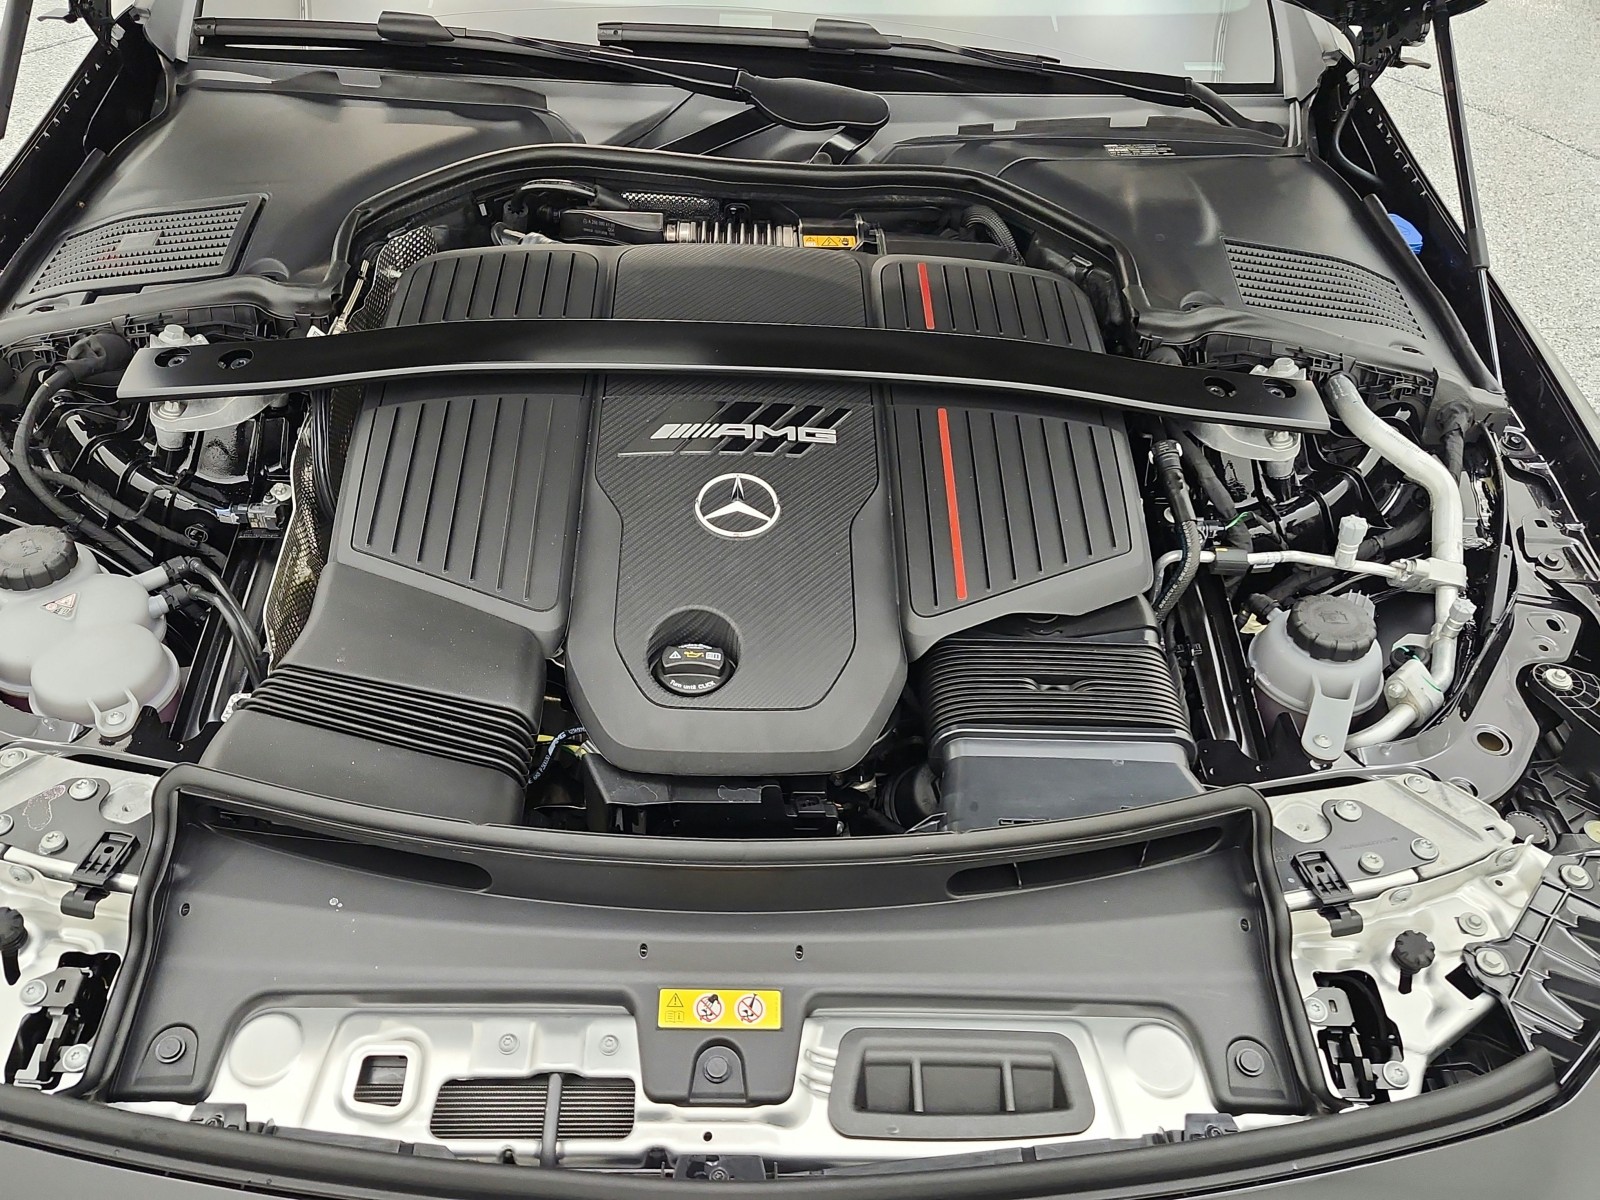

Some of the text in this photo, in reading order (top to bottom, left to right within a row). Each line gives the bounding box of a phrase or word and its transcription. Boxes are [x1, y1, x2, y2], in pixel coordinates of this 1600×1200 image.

[709, 423, 837, 444] AMG
[670, 680, 682, 688] Turn
[698, 681, 716, 689] CLICK
